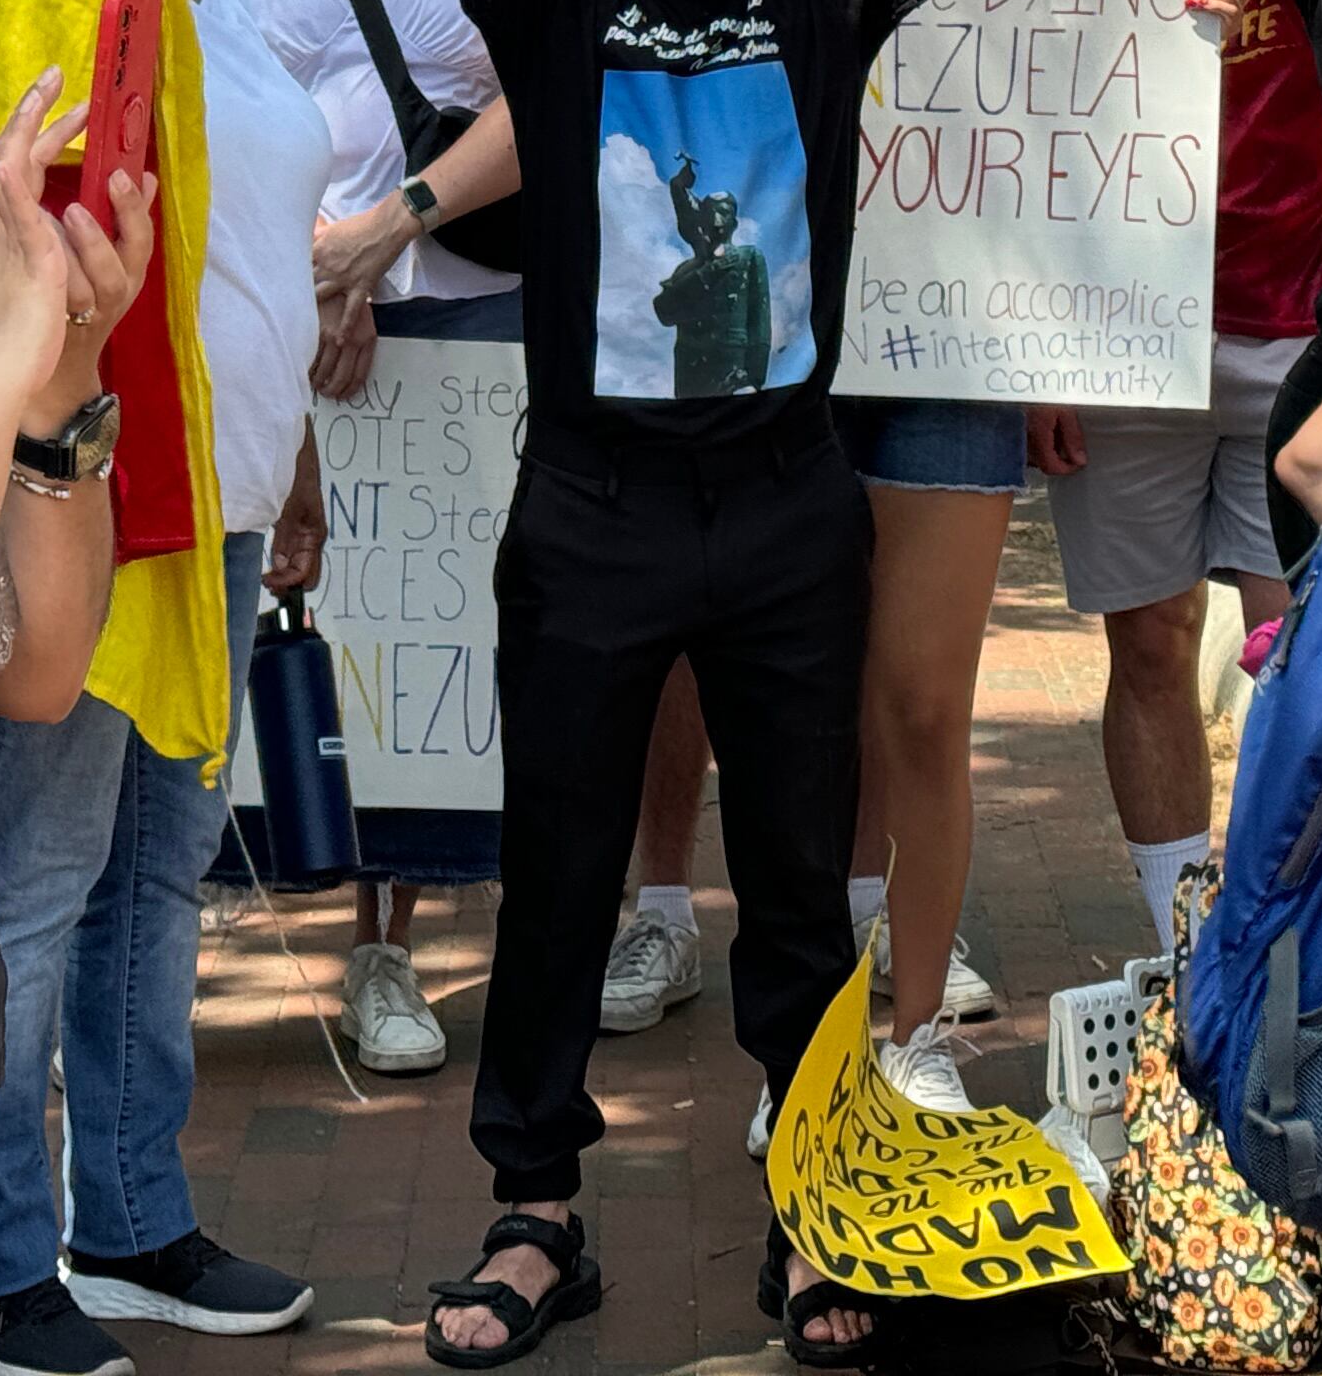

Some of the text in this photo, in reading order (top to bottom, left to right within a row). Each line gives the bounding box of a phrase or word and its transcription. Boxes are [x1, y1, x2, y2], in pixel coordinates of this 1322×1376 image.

[858, 125, 1201, 227] YOUR EYES
[860, 255, 1200, 338] be an accomplice
[984, 366, 1173, 400] community
[322, 409, 471, 476] OTES
[961, 1239, 1099, 1290] NO
